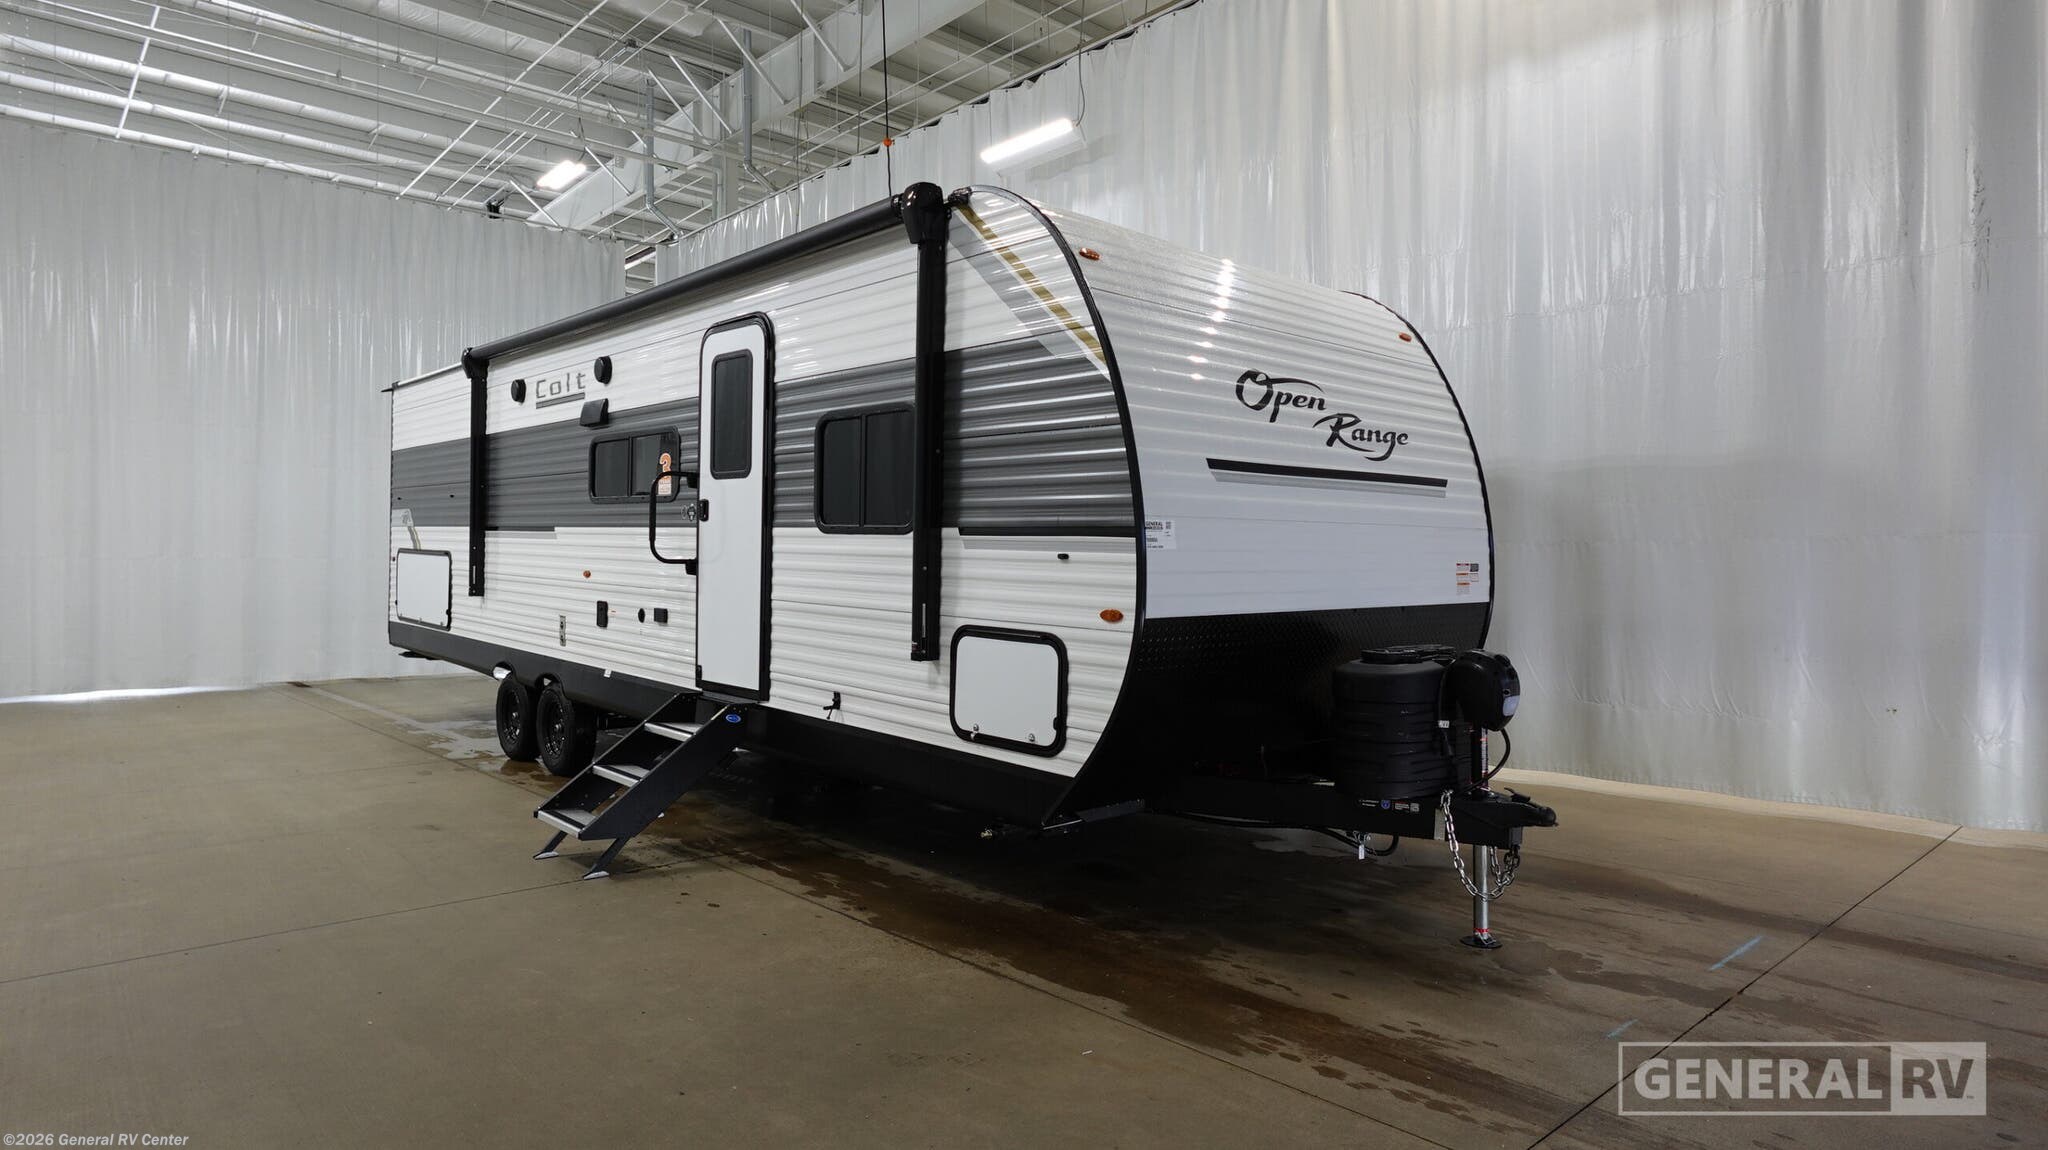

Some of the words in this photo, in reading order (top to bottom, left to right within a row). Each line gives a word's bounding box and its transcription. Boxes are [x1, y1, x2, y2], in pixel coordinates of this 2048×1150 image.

[535, 372, 586, 399] Colt
[1235, 368, 1327, 423] Open
[1312, 412, 1409, 462] Range
